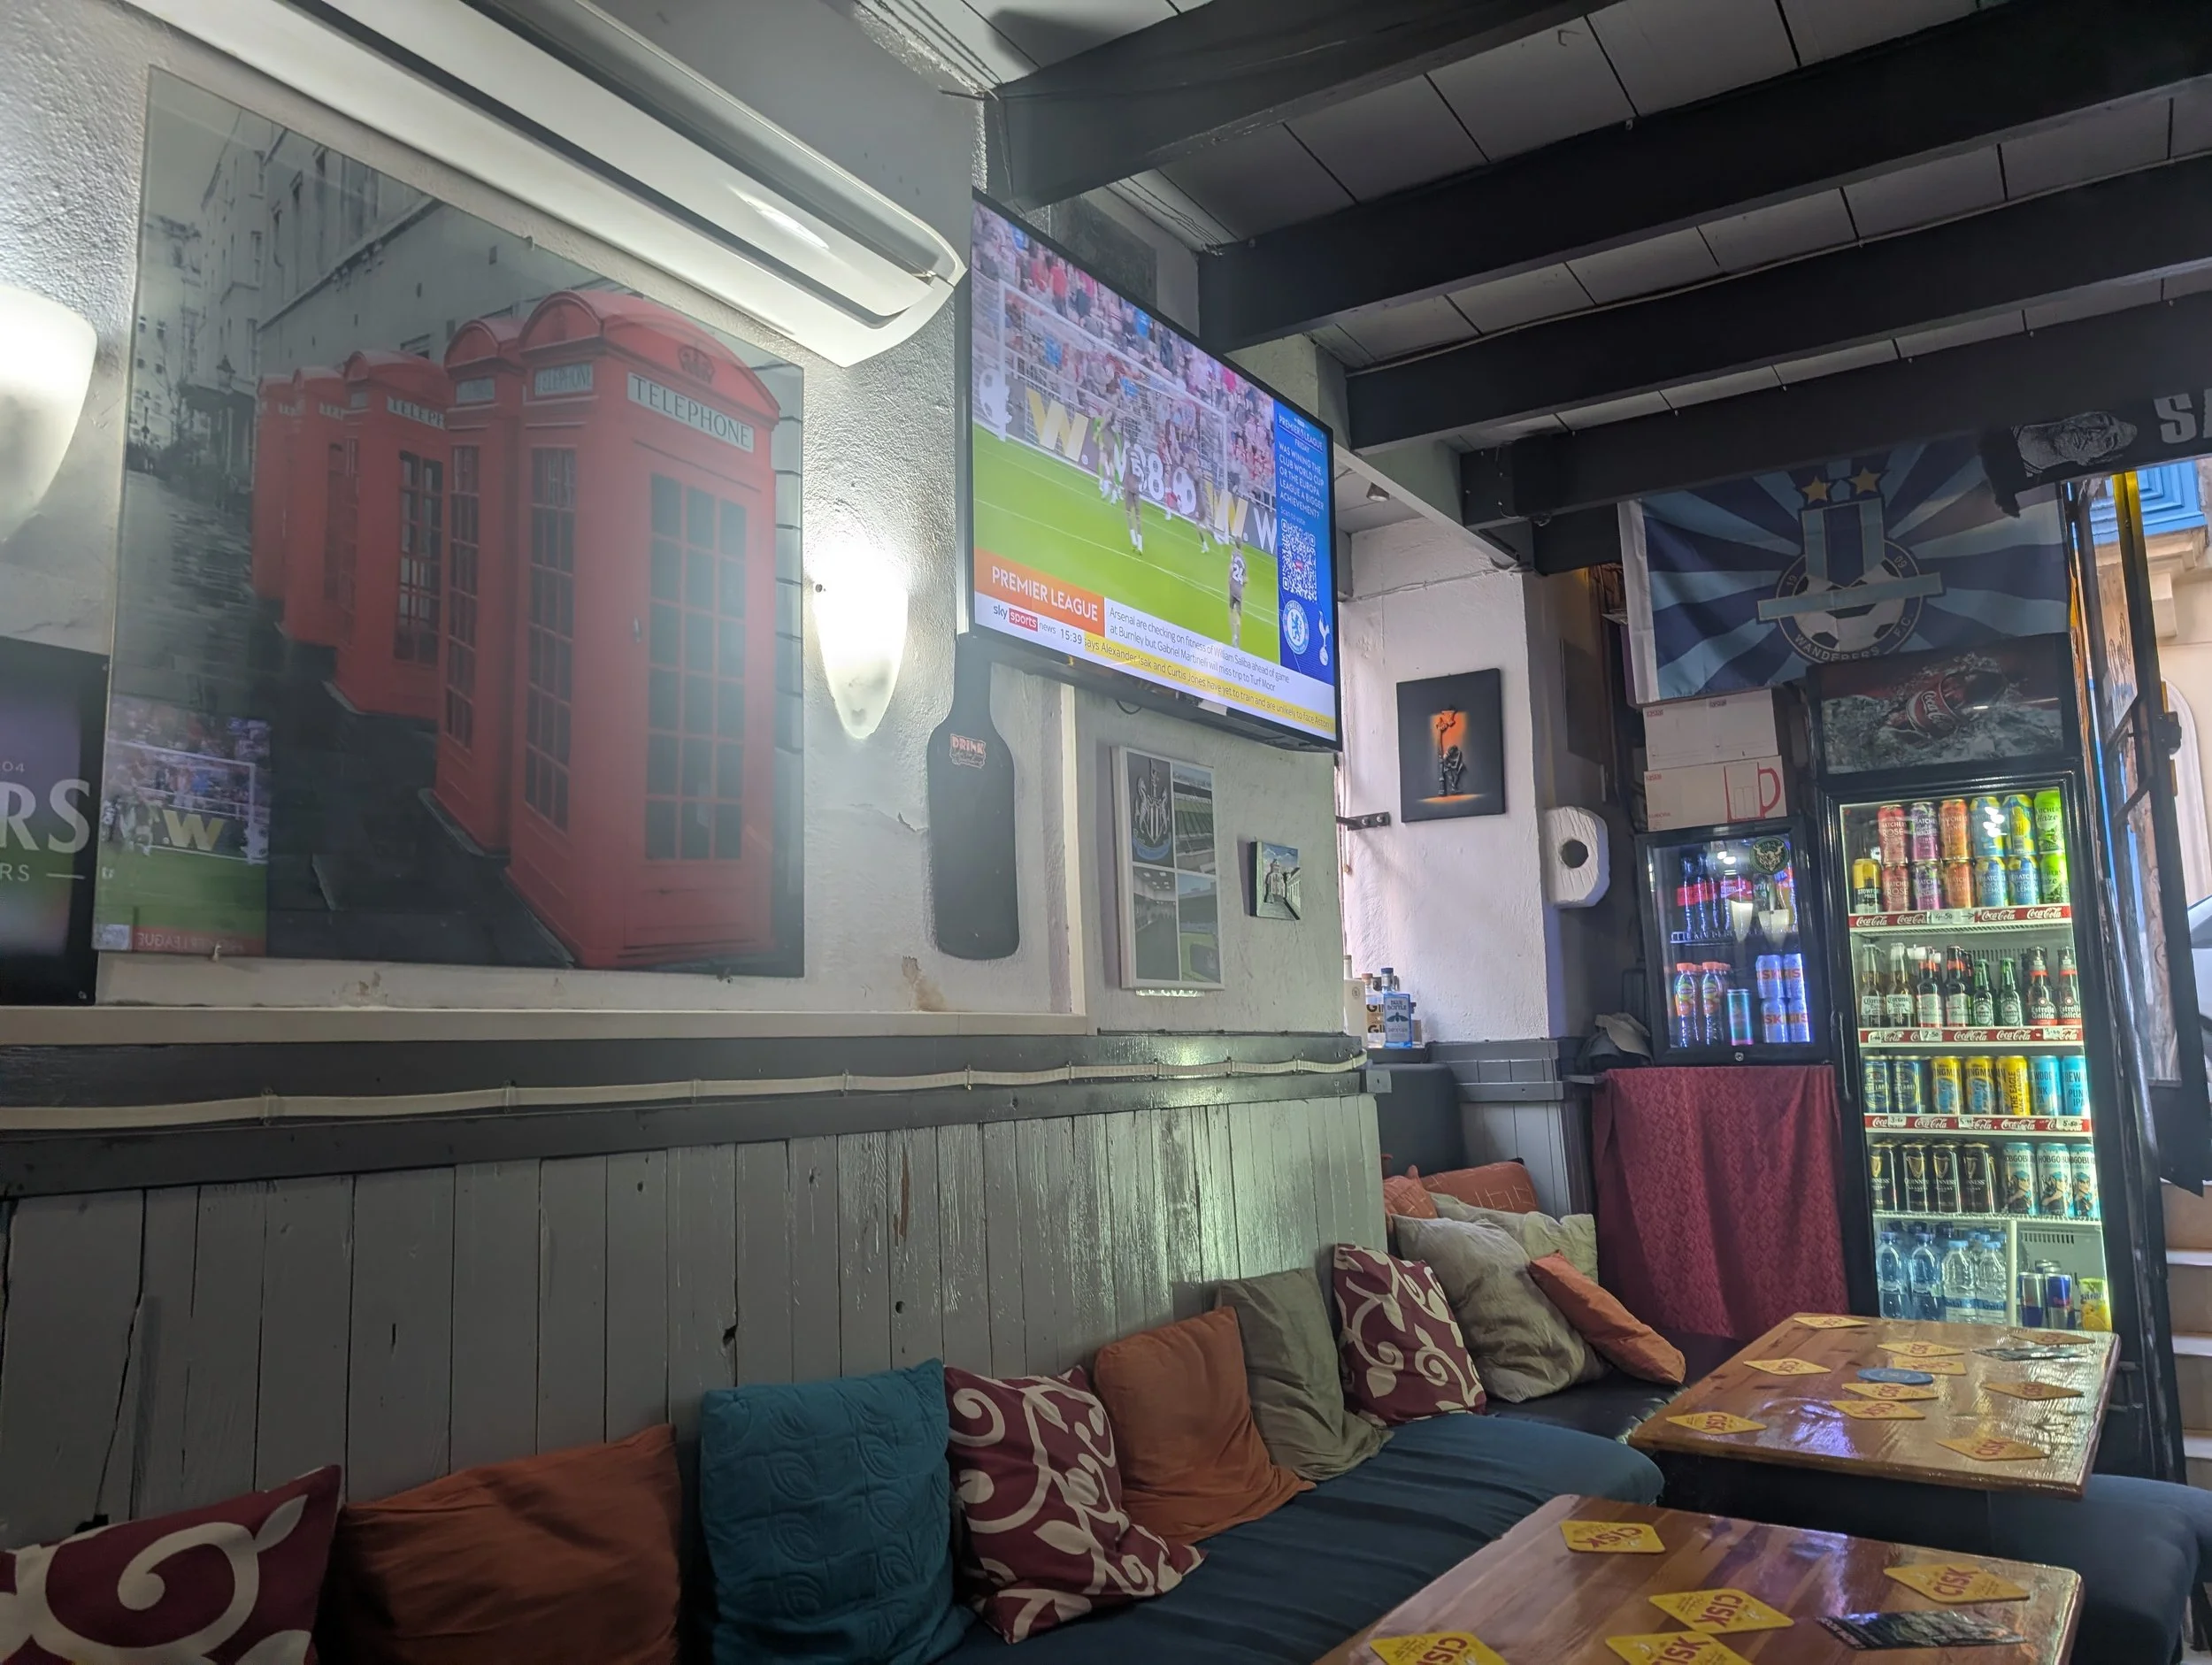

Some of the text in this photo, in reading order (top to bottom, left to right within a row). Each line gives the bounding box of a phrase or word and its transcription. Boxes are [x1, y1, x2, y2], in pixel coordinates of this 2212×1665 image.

[633, 375, 750, 449] TELEPHONE
[1279, 441, 1291, 457] WAS
[1311, 461, 1322, 475] THE
[1294, 438, 1310, 453] FRIDAY
[1279, 454, 1325, 488] CLUB WORLD CUP
[1279, 465, 1320, 496] OR THE EUROPA
[1279, 479, 1324, 511] LEAGUE A BIGGER
[1279, 491, 1320, 519] ACHIEVEMENT?
[992, 565, 1098, 622] PREMIER LEAGUE
[994, 604, 1056, 634] sky sports news
[1061, 628, 1082, 645] 15:39
[1110, 607, 1290, 684] Arsenal are checking on fitness of William Saliba ahead of game
[1110, 625, 1276, 692] at Burnley but Gabriel Martinelli will miss trip to Turf Moor
[1101, 642, 1137, 662] Alexander
[1138, 655, 1151, 668] Isak
[1153, 663, 1166, 673] and
[1168, 666, 1187, 680] Curtis
[1187, 672, 1206, 687] Jones
[1206, 679, 1222, 693] have
[1222, 687, 1233, 698] yet
[1233, 689, 1240, 699] to
[1240, 691, 1255, 704] train
[1255, 695, 1266, 707] and
[1266, 701, 1276, 711] are
[1276, 703, 1296, 719] unlikely
[1302, 712, 1315, 725] face
[1314, 717, 1330, 728] Aston
[951, 735, 984, 755] DRINK
[2008, 1071, 2018, 1094] EAGLE
[1573, 1527, 1642, 1548] CISK
[1933, 1567, 1978, 1596] CISK
[1694, 1593, 1743, 1628] CISK
